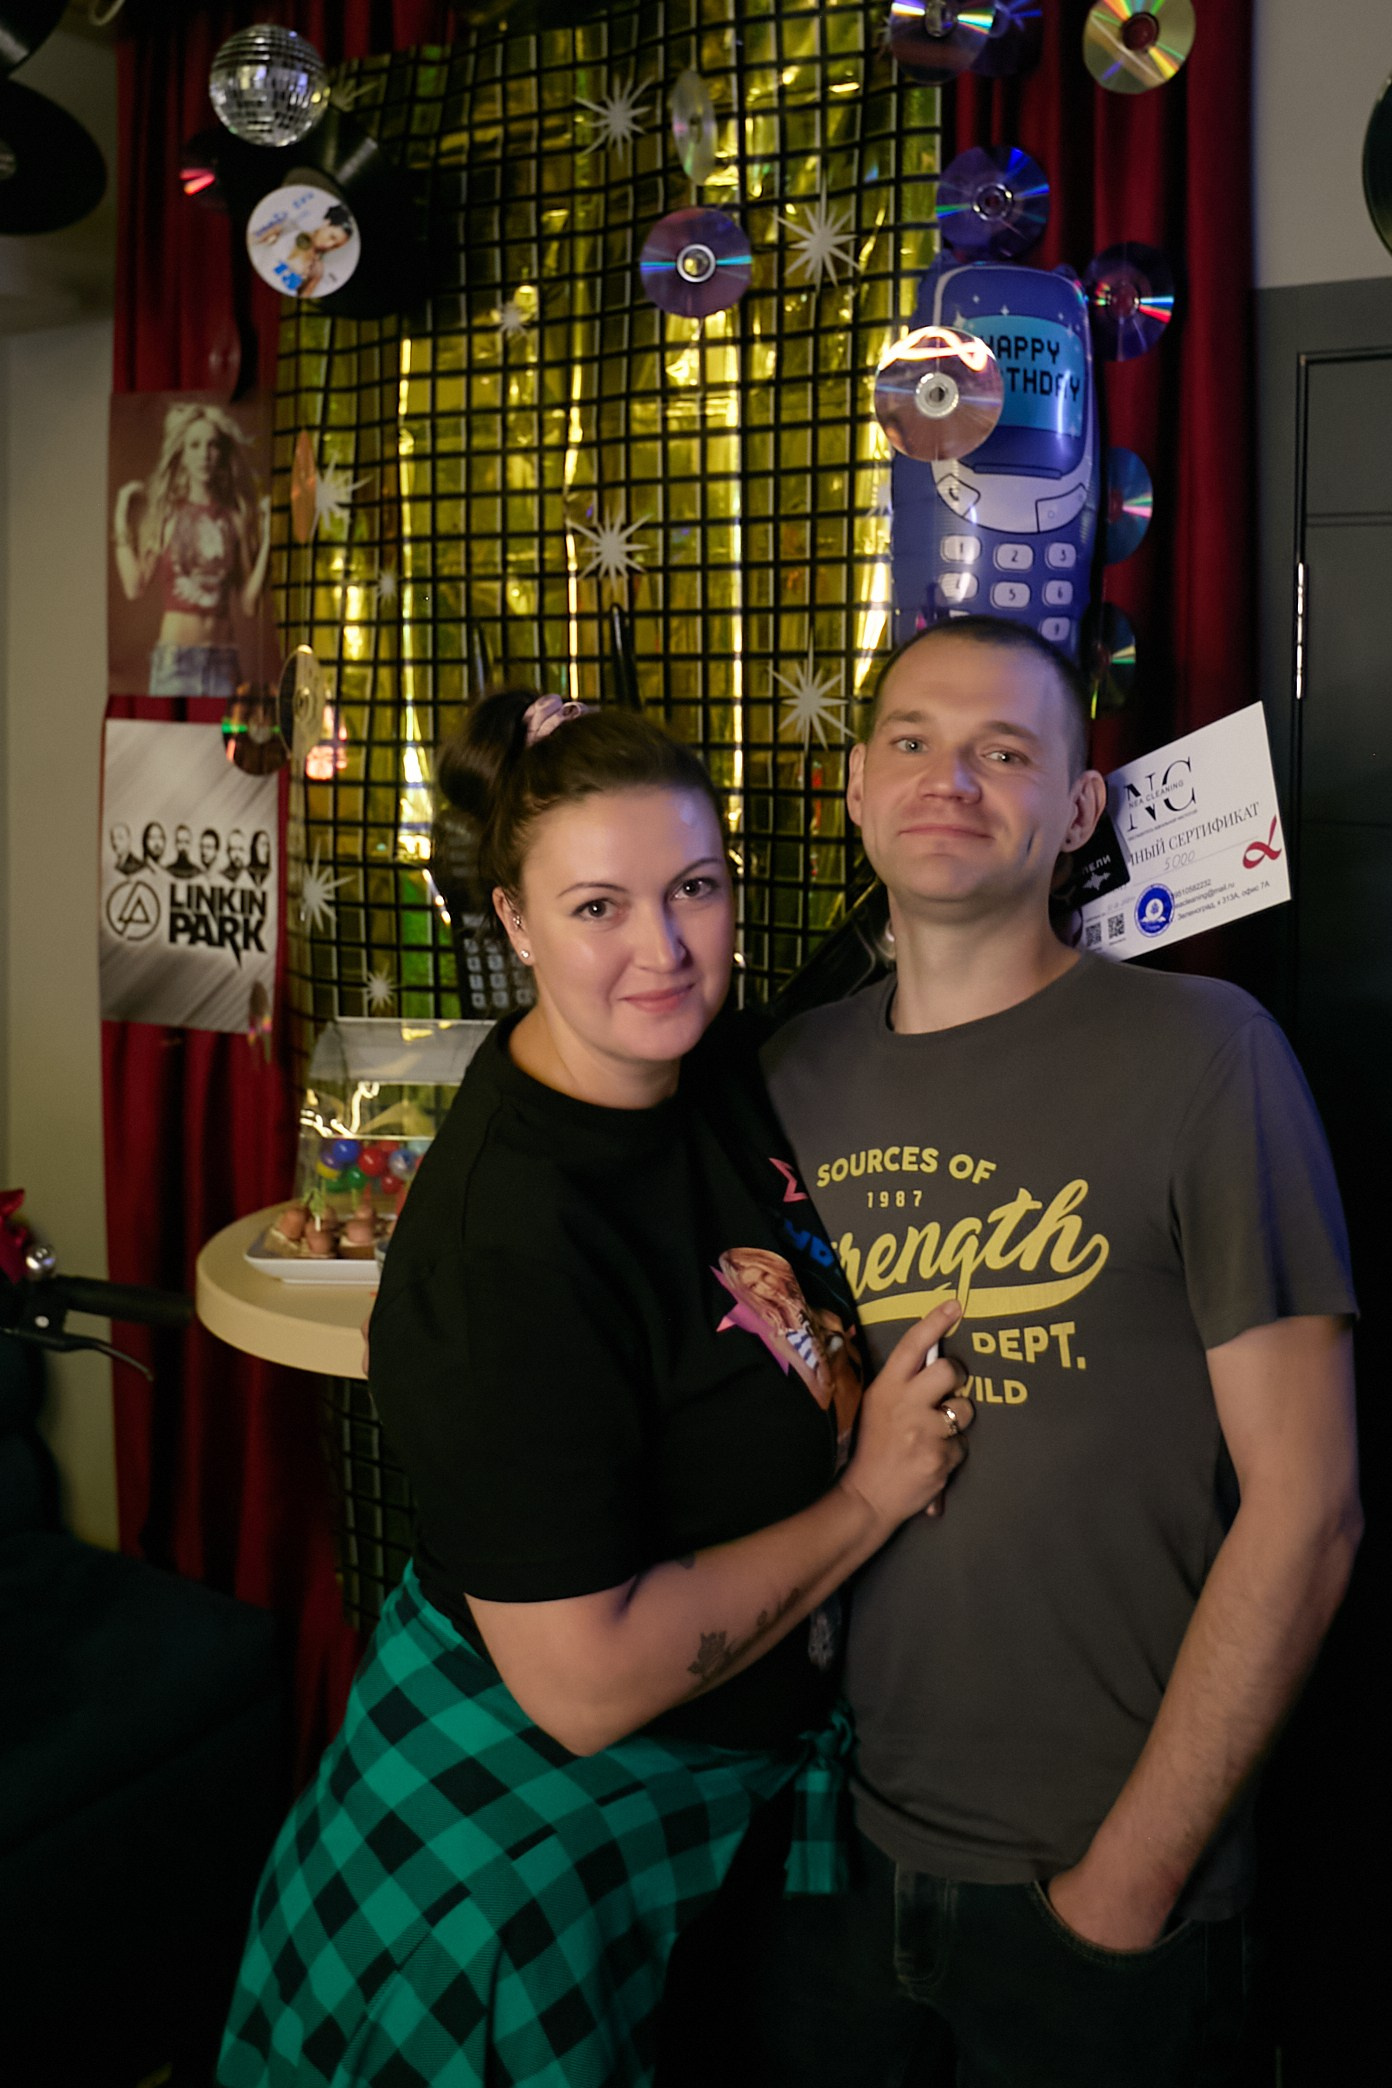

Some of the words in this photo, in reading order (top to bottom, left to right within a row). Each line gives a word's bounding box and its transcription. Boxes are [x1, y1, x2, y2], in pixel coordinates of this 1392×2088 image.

[1001, 367, 1080, 401] THDAY
[1011, 550, 1018, 563] 2
[1124, 756, 1196, 832] NC
[1129, 799, 1144, 809] NEA
[1145, 780, 1184, 802] CLEANING
[1168, 802, 1260, 851] СЕРТИФИКАТ
[1164, 851, 1195, 871] 5000
[170, 882, 267, 922] LINKIN
[169, 912, 267, 969] PARK
[817, 1146, 939, 1188] SOURCES
[949, 1153, 997, 1185] OF
[866, 1190, 923, 1208] 1987
[831, 1179, 1109, 1338] rength
[971, 1321, 1087, 1370] DEPT.
